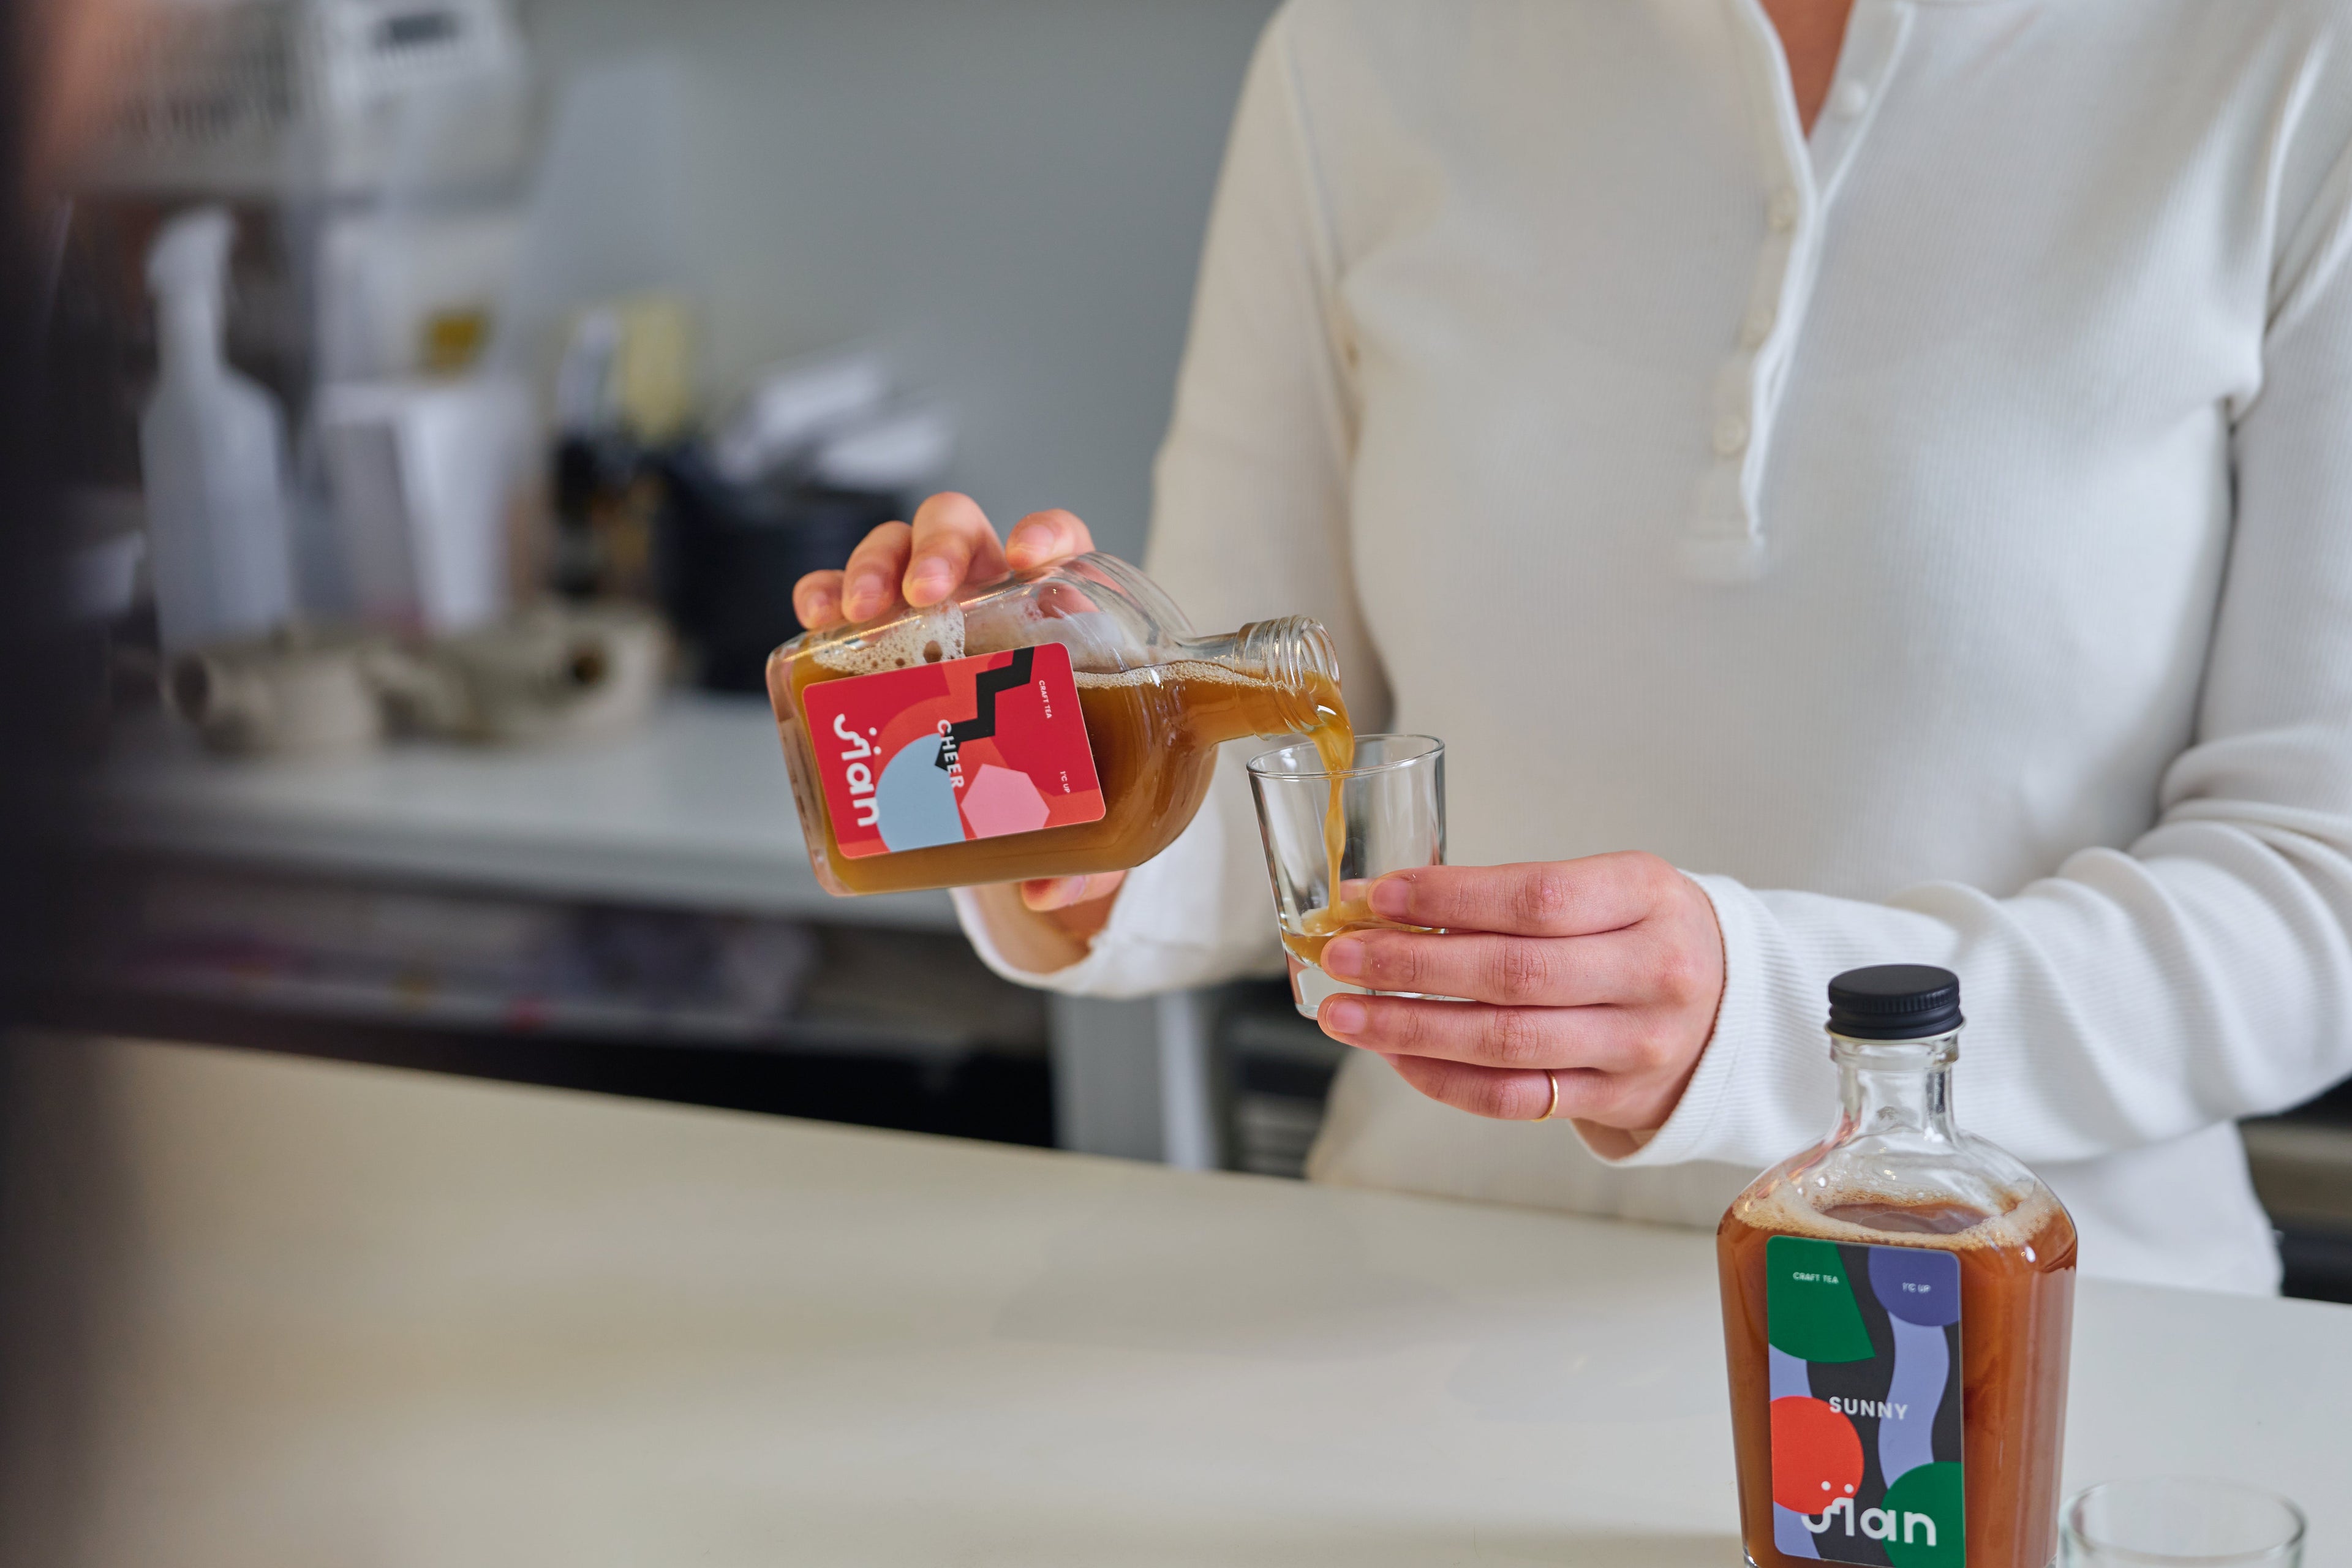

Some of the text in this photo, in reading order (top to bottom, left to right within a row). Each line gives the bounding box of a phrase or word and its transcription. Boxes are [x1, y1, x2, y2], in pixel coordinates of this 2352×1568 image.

[1039, 680, 1052, 719] CRAFT TEA
[937, 719, 965, 788] CHEER
[1063, 783, 1071, 794] UP
[1792, 1272, 1839, 1284] CRAFT TEA
[1917, 1284, 1931, 1294] UP
[1829, 1396, 1908, 1420] SUNNY
